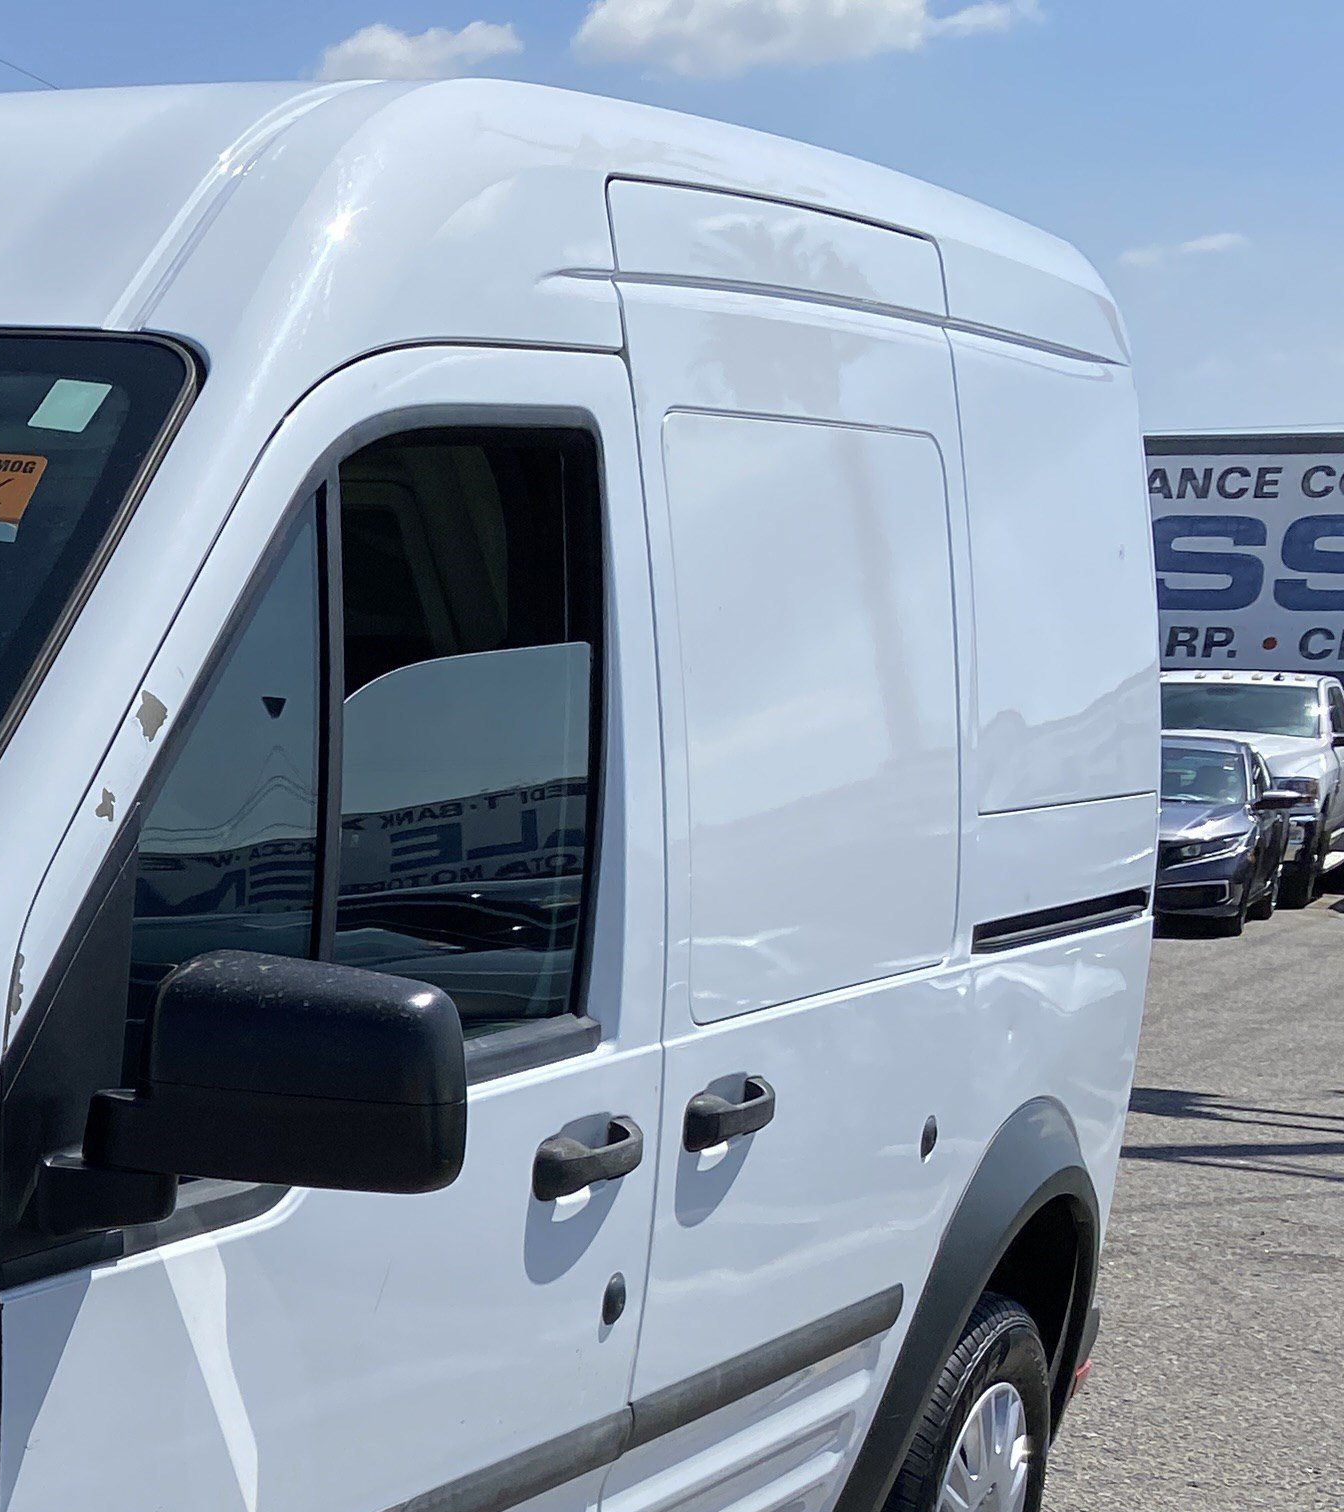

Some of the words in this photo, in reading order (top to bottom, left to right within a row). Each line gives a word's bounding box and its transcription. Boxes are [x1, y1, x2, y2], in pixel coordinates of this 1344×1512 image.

[1301, 465, 1344, 498] C
[1165, 626, 1237, 658] RP.
[1299, 627, 1344, 660] C
